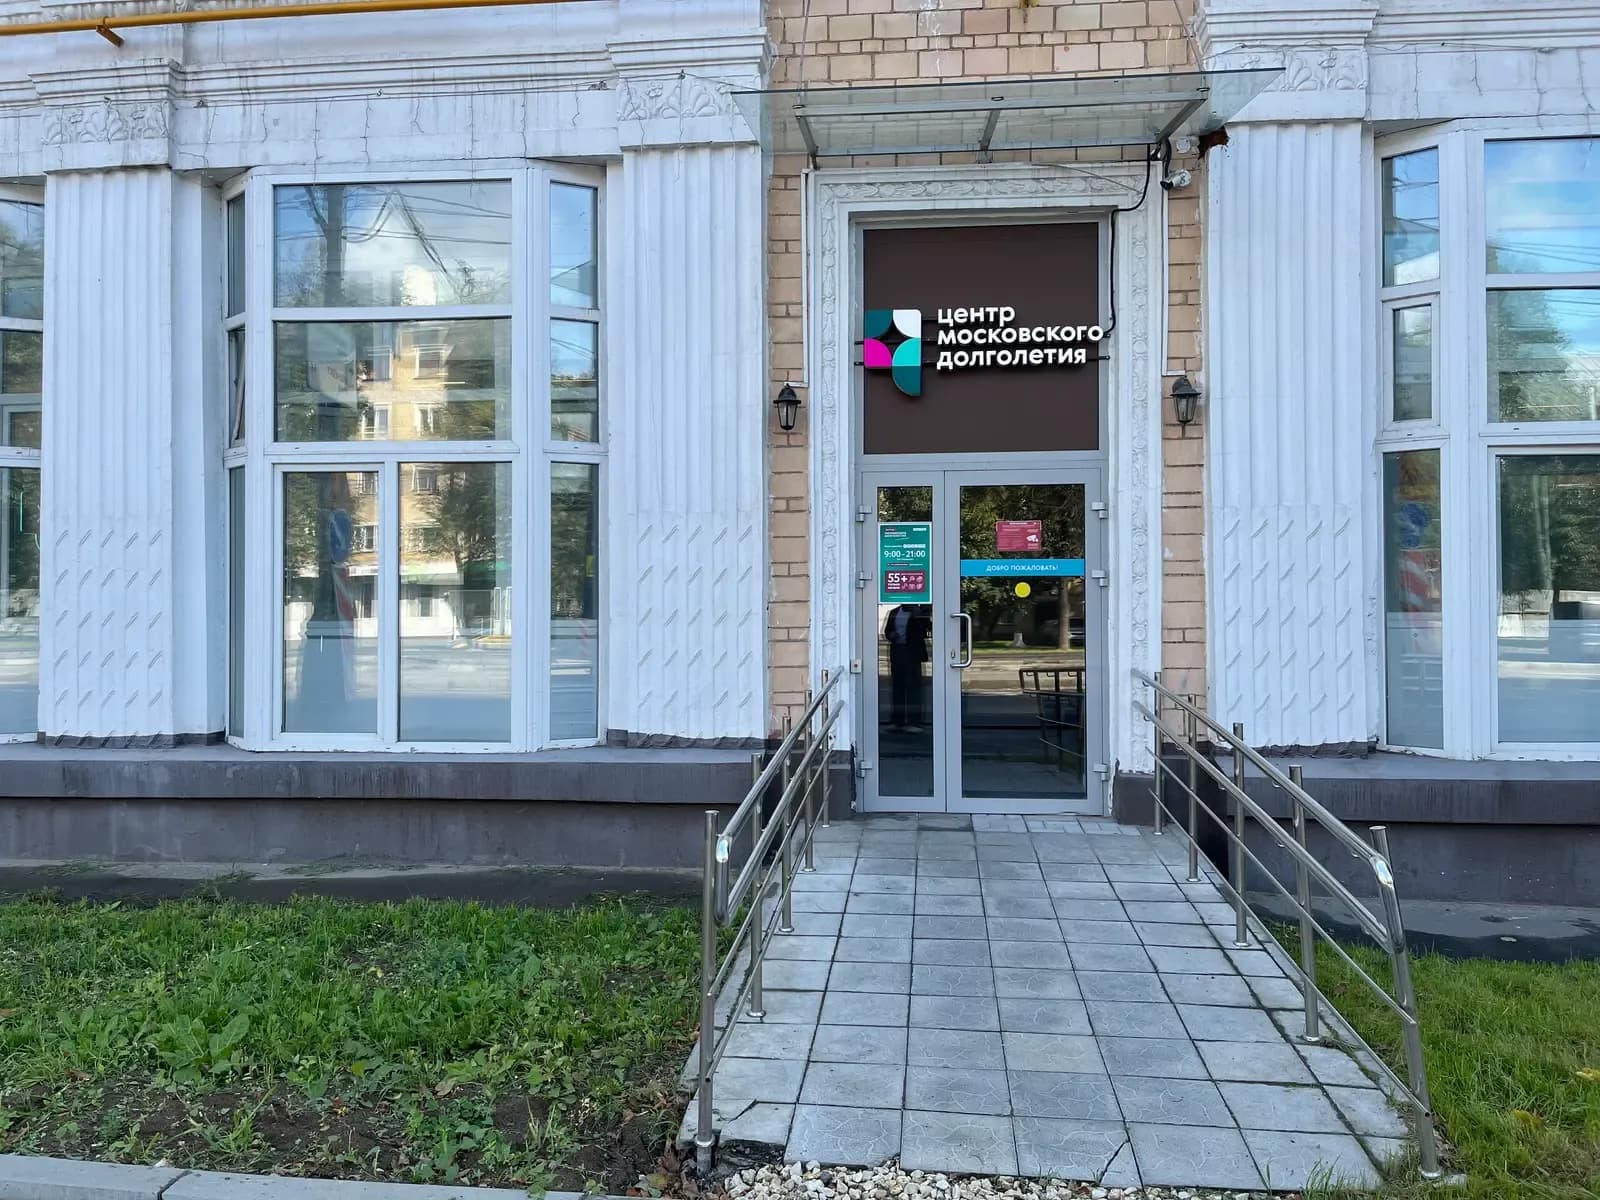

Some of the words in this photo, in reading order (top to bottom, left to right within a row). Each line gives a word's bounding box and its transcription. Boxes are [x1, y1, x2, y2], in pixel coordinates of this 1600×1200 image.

[937, 306, 1015, 326] центр
[937, 325, 1104, 345] московского
[936, 348, 1087, 370] долголетия
[887, 572, 908, 583] 55+
